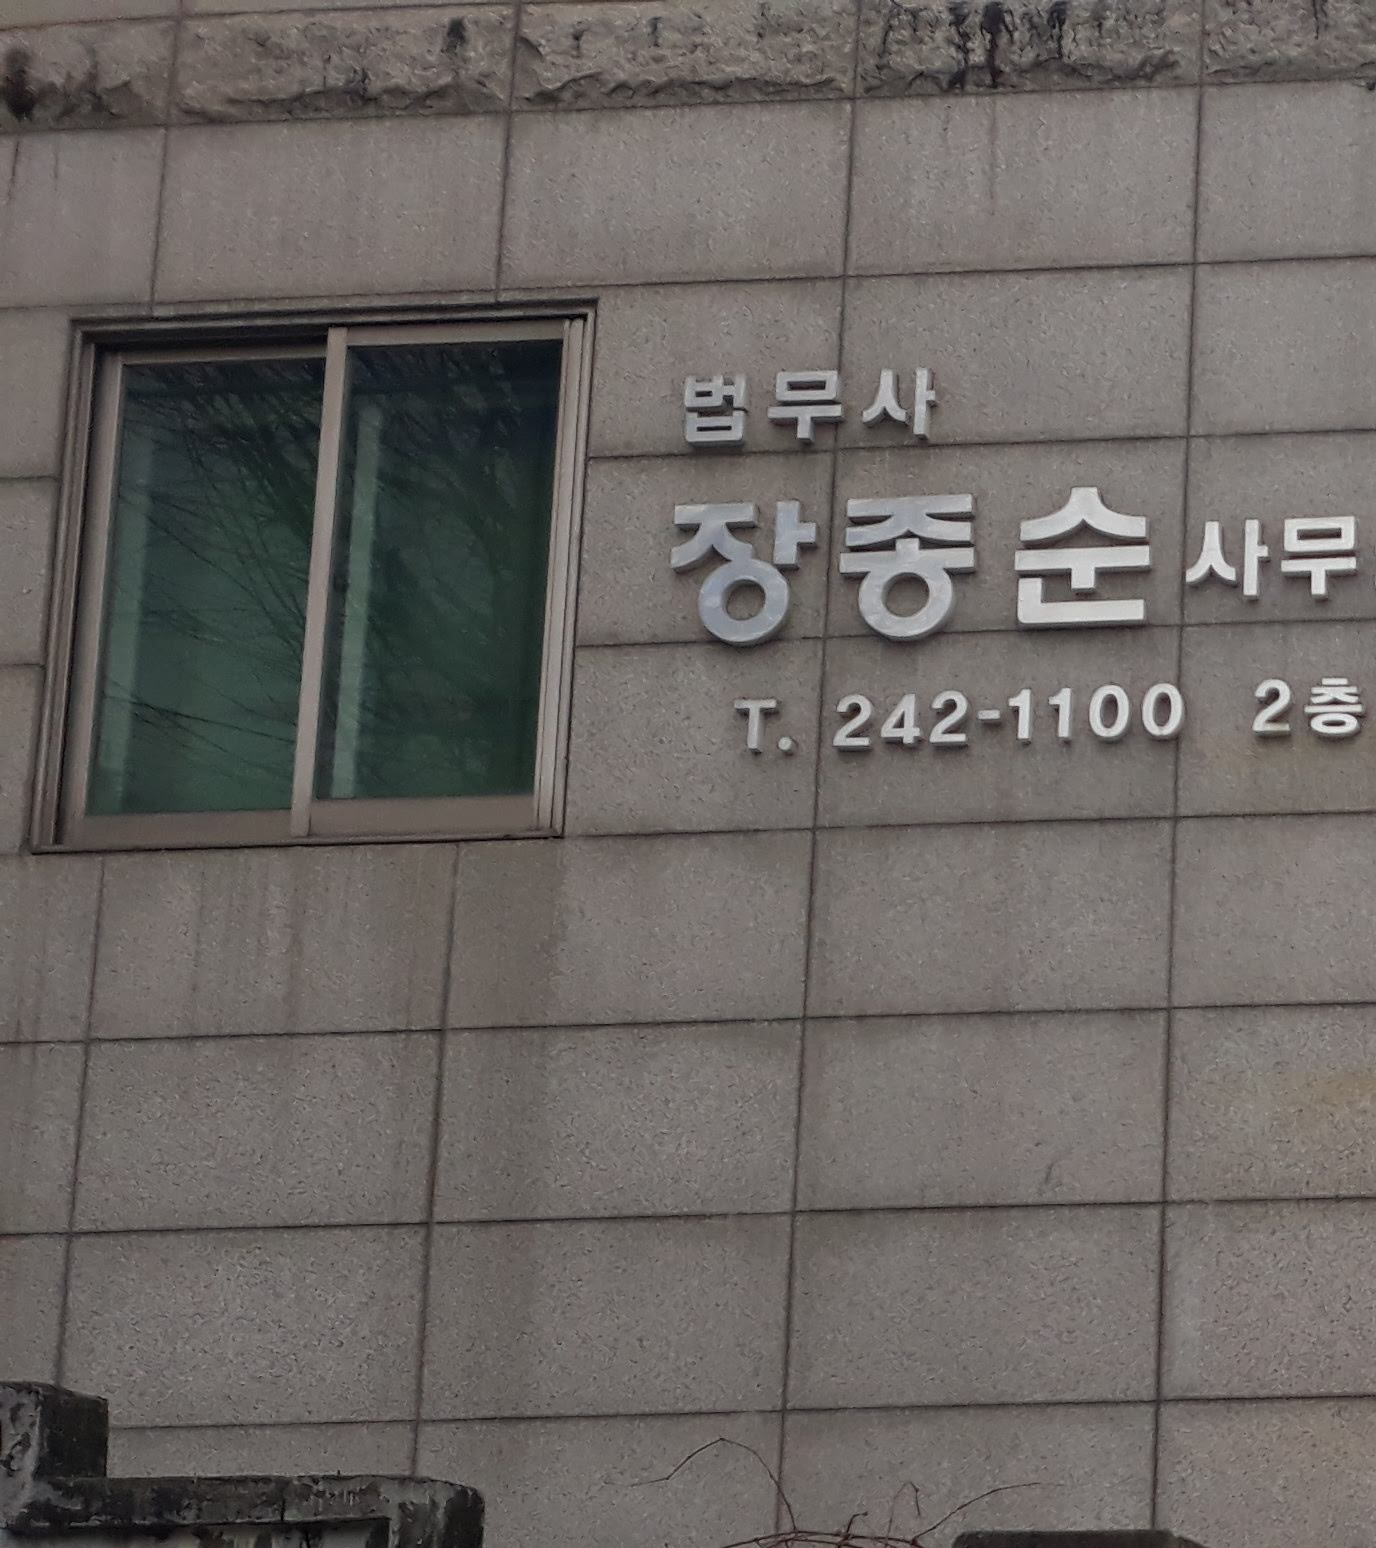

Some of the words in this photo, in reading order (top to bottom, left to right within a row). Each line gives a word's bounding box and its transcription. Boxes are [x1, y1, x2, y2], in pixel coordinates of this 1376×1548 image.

[683, 366, 938, 449] 법무사
[669, 486, 1153, 647] 장종순
[830, 681, 1187, 753] 242-1100
[1252, 676, 1367, 739] 2층
